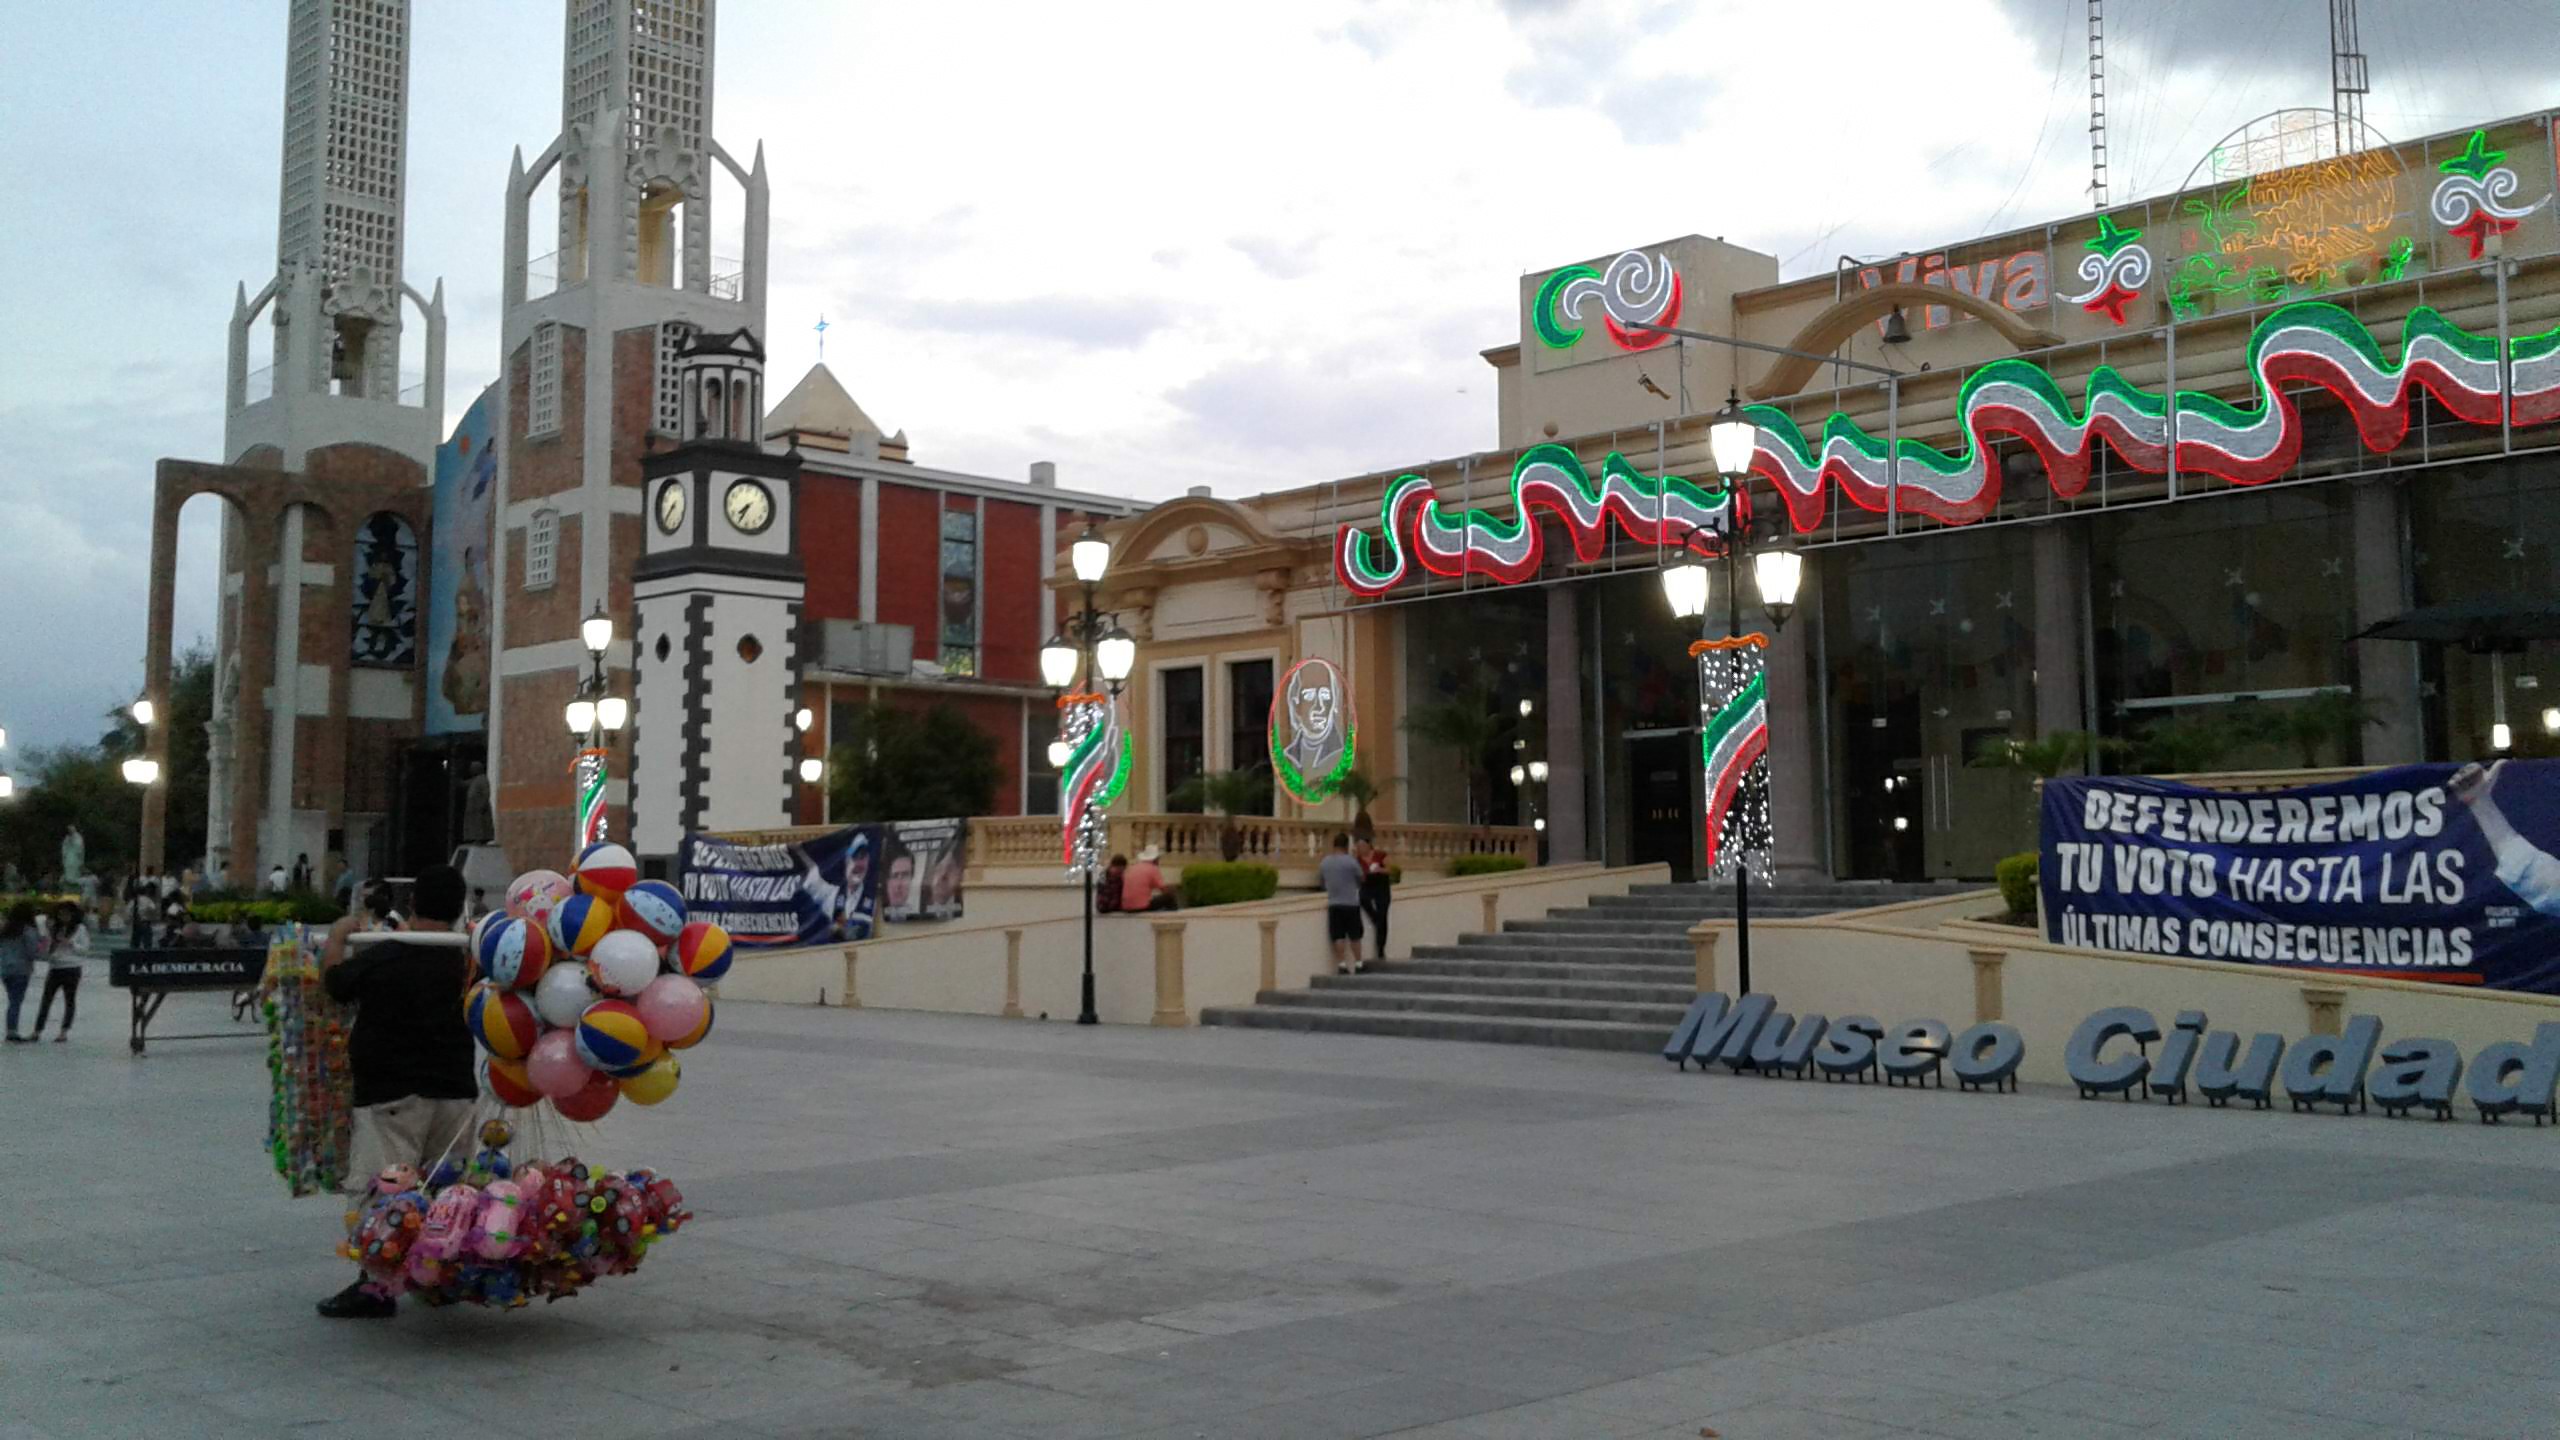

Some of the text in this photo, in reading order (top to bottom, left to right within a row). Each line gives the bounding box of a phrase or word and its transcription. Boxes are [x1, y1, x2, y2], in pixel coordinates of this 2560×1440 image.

[2084, 788, 2447, 843] DEFENDEREMOS
[684, 872, 698, 900] TU
[729, 876, 775, 901] HASTA
[769, 875, 801, 901] LAS
[2057, 842, 2465, 904] TU VOTO HASTA LAS
[2062, 904, 2474, 967] ÚLTIMAS CONSECUENCIAS
[129, 961, 245, 975] LA DEMOCRACIA
[1663, 991, 2560, 1115] Museo Ciudad
